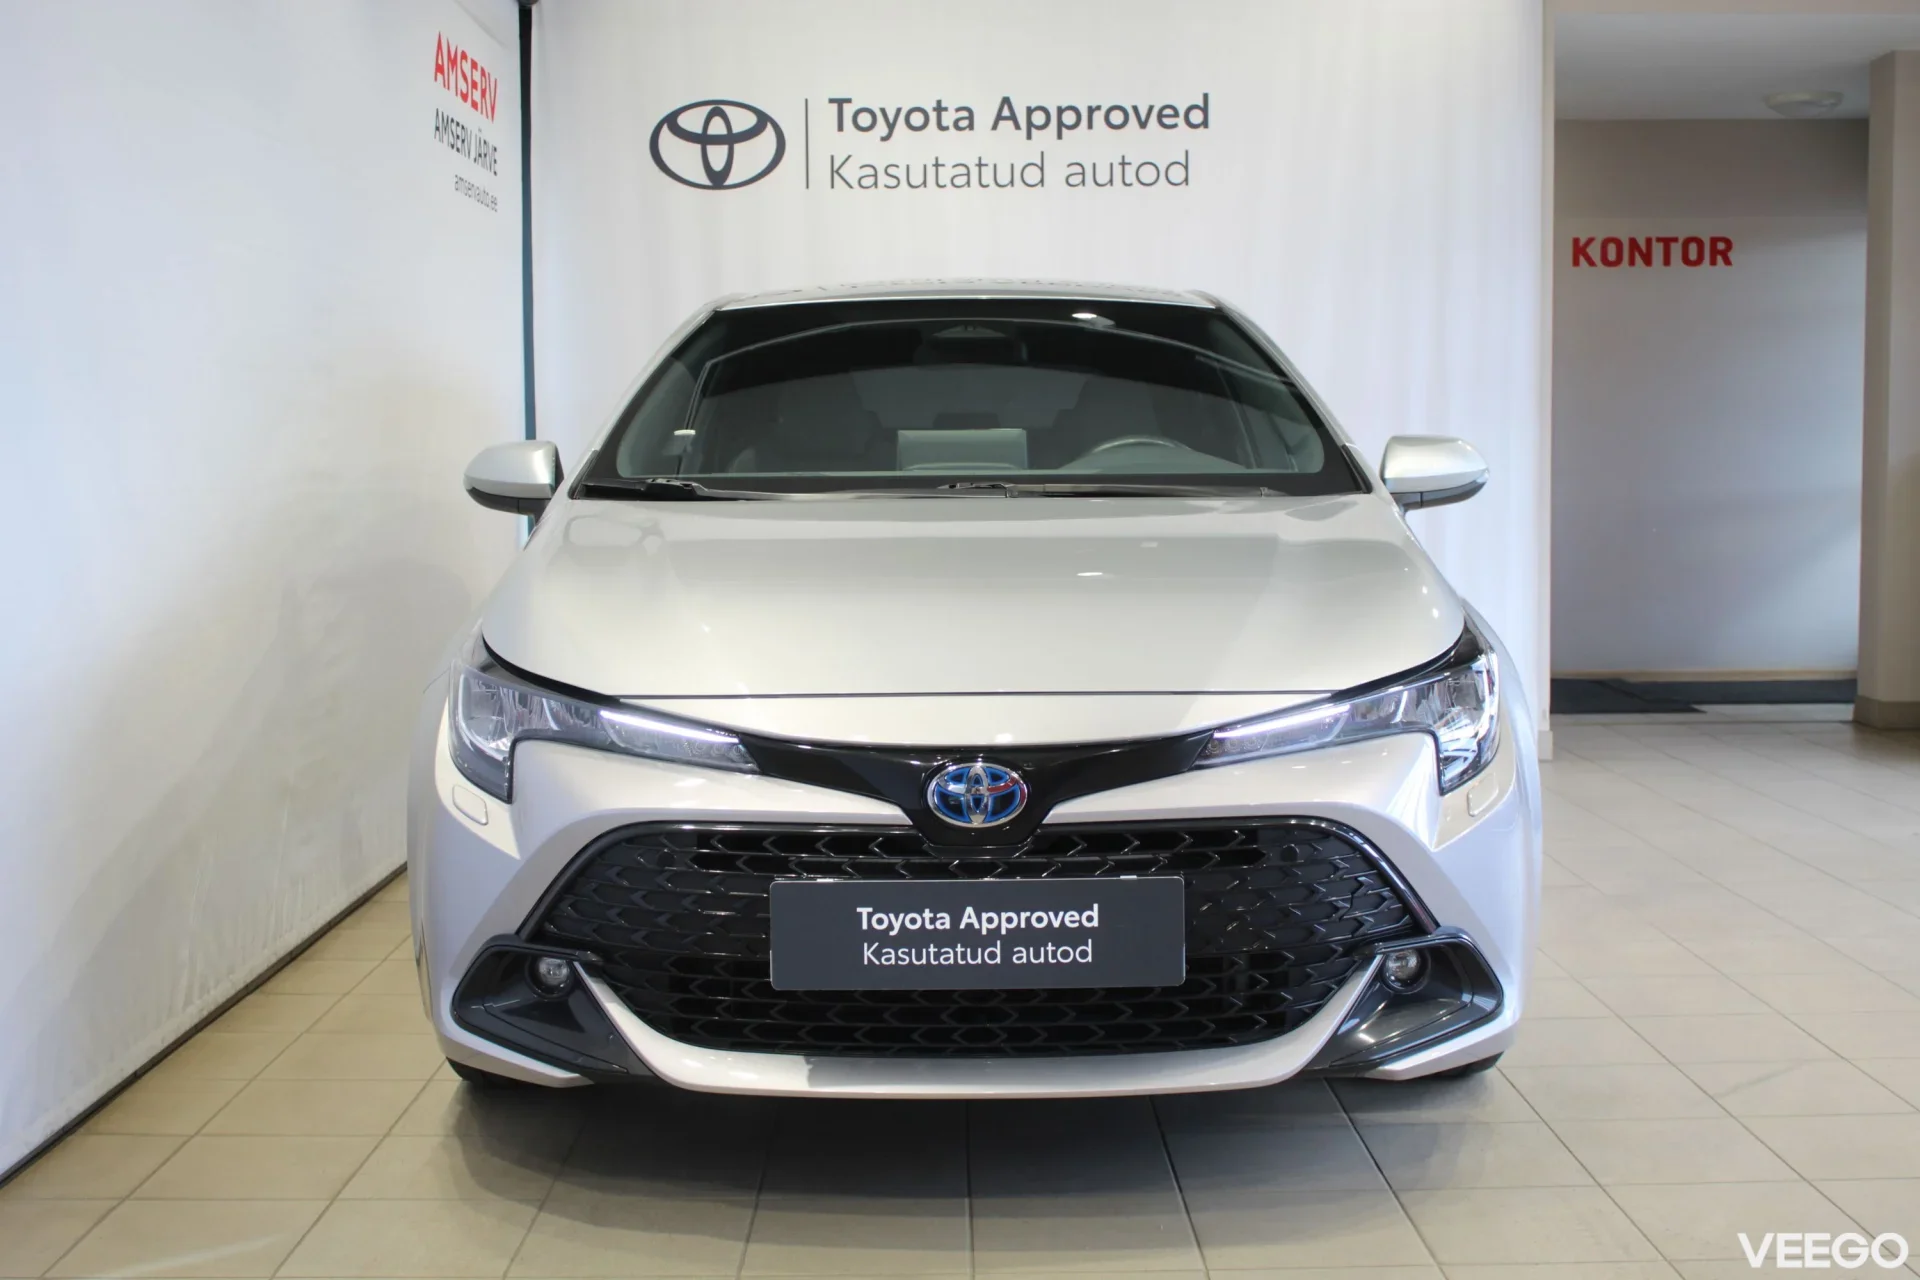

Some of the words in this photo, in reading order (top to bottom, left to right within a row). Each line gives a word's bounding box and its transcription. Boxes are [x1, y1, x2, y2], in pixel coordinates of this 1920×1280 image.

[434, 31, 498, 123] AMSERV
[828, 97, 976, 142] Toyota
[991, 93, 1211, 141] Approved
[434, 108, 473, 160] AMSERV
[473, 127, 498, 177] JÄRVE
[829, 151, 1045, 189] Kasutatud
[1064, 150, 1190, 188] autod
[1571, 236, 1734, 268] KONTOR
[856, 907, 951, 936] Toyota
[959, 904, 1100, 935] Approved
[862, 940, 1001, 966] Kasutatud
[1012, 939, 1093, 964] autod
